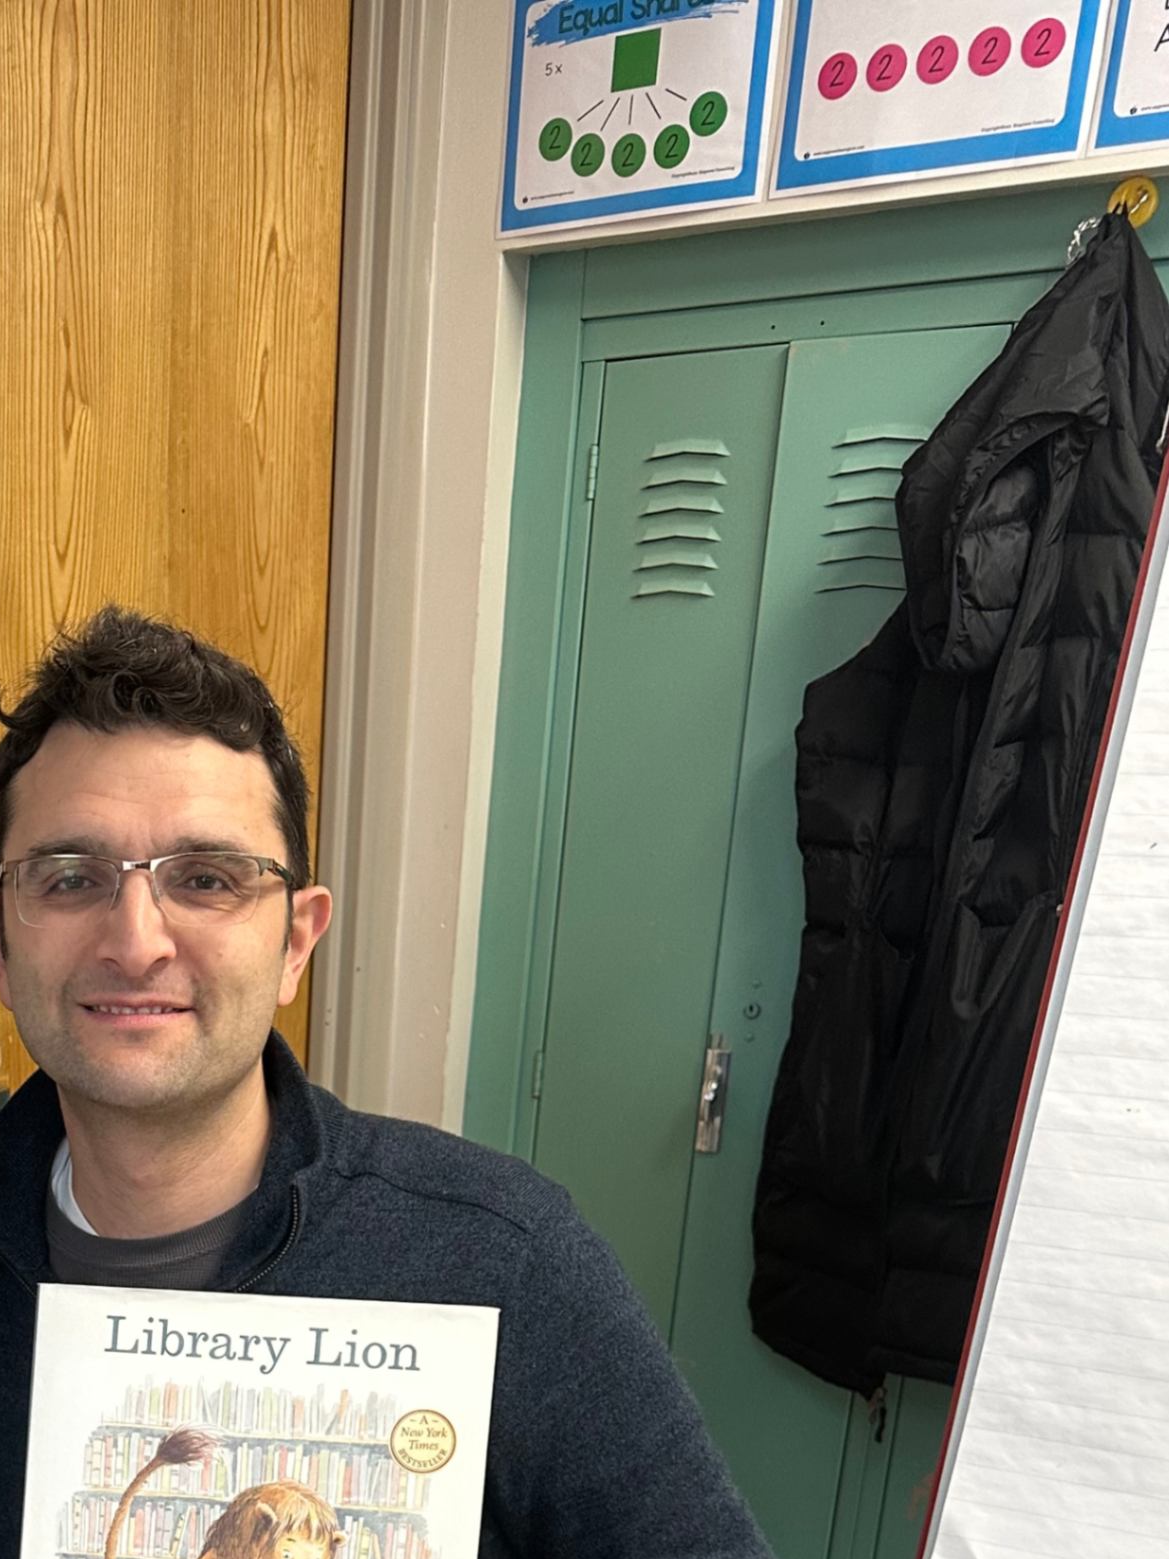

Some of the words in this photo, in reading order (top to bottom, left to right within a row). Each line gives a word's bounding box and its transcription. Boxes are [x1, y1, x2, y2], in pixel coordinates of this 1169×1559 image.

[558, 0, 623, 35] Equal
[829, 61, 845, 87] 2
[876, 54, 893, 82] 2
[928, 46, 945, 73] 2
[981, 37, 998, 65] 2
[1034, 28, 1052, 57] 2
[548, 125, 562, 150] 2
[580, 142, 593, 167] 2
[622, 142, 635, 167] 2
[665, 133, 679, 159] 2
[701, 100, 715, 126] 2
[103, 1315, 292, 1375] Library
[306, 1327, 421, 1372] Lion
[400, 1427, 424, 1438] New
[426, 1427, 448, 1439] York
[419, 1415, 429, 1425] A
[398, 1448, 447, 1468] BESTSELLER
[408, 1439, 439, 1450] Times
